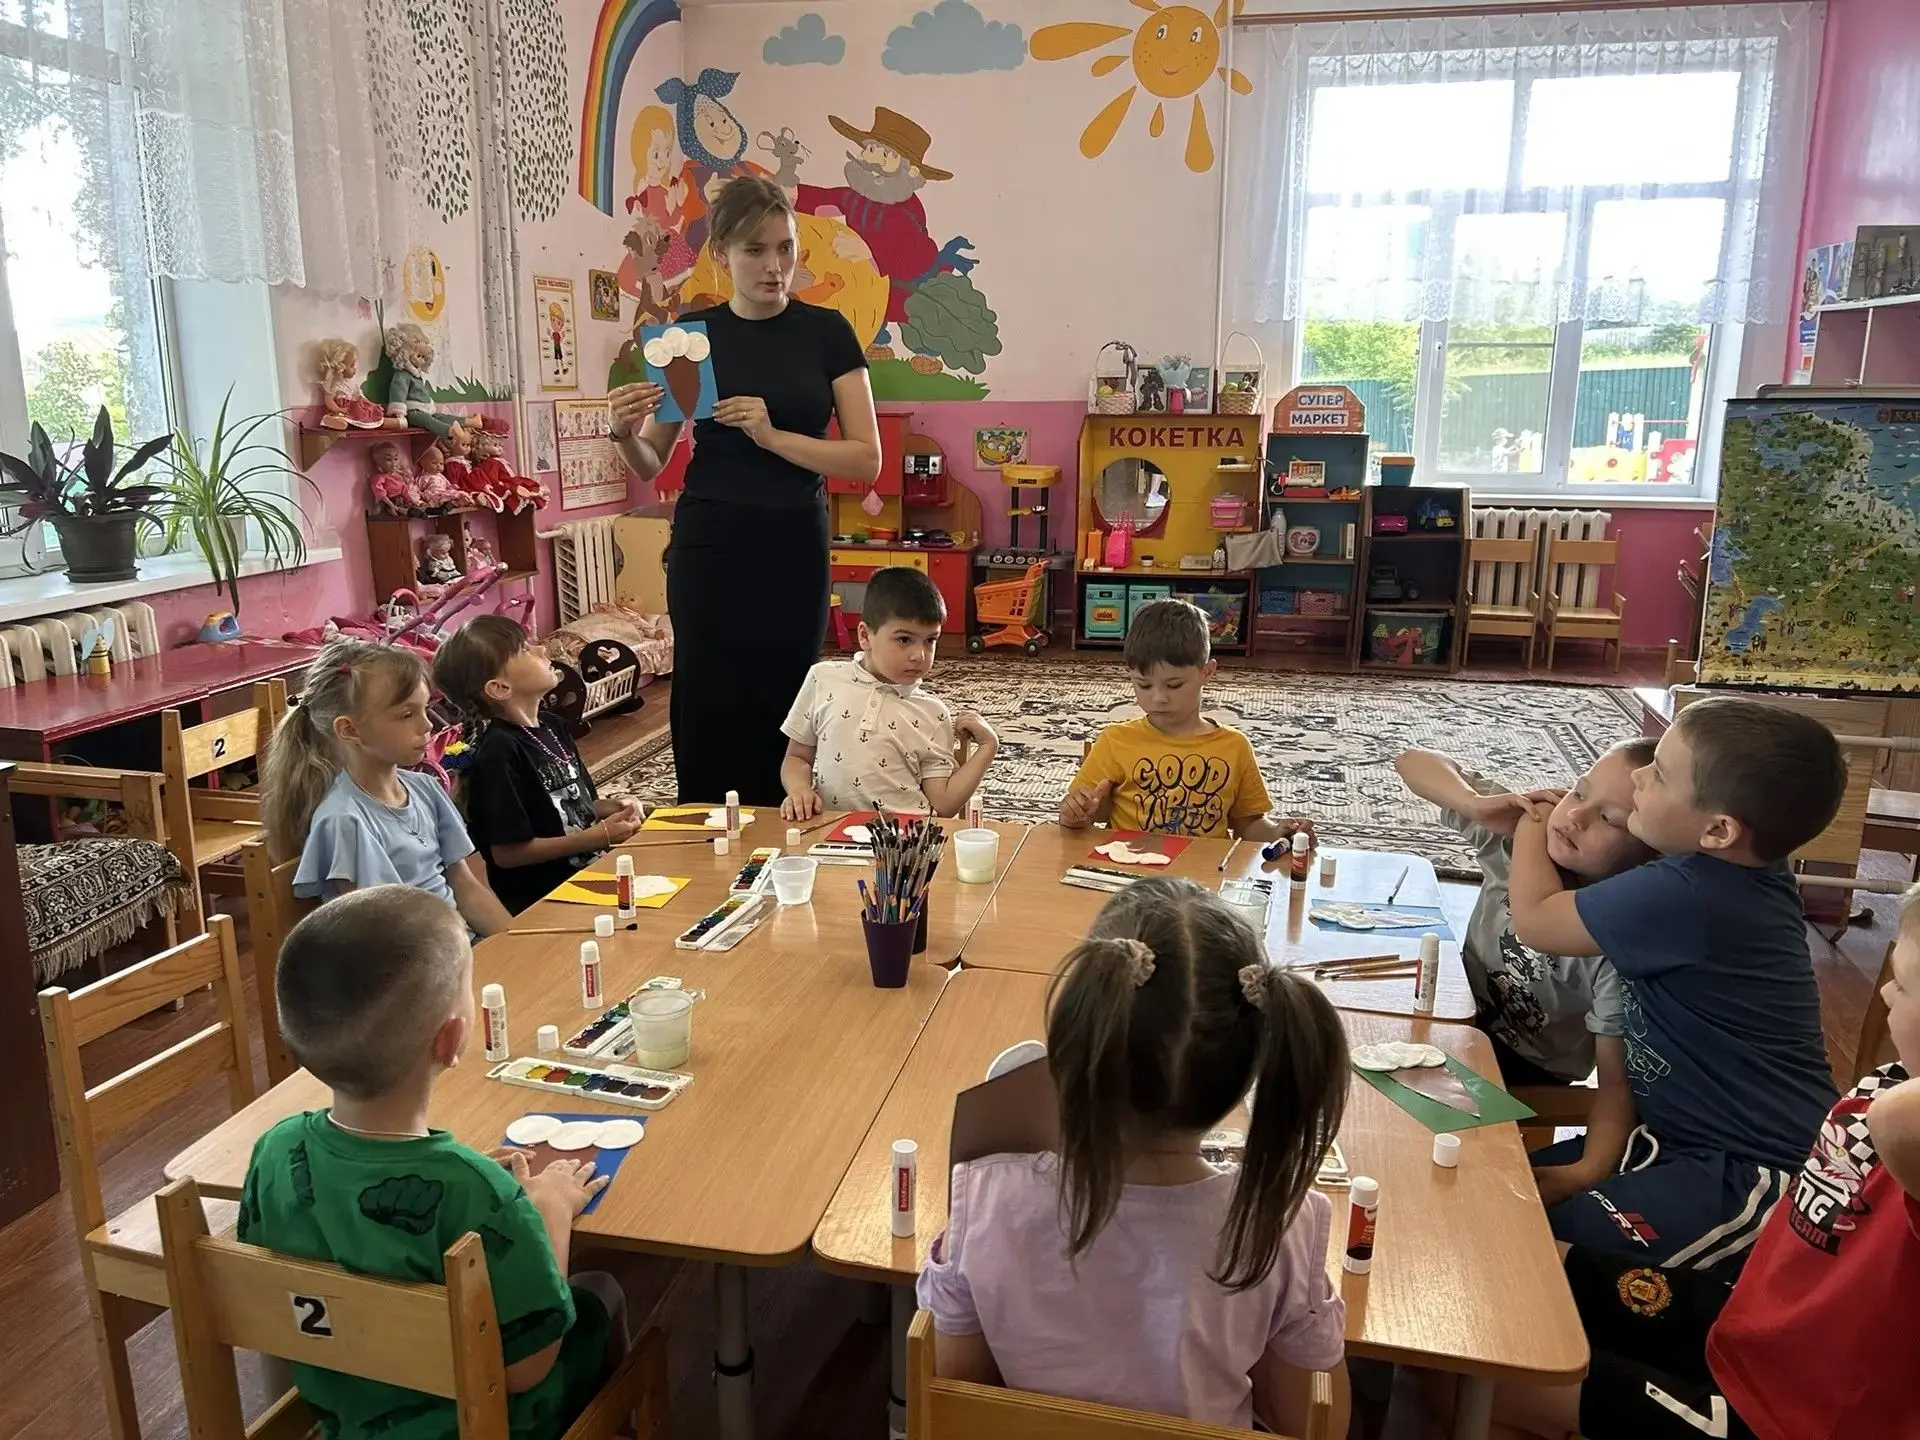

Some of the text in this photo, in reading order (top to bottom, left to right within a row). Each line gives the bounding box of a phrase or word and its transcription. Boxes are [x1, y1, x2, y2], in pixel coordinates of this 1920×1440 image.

[1298, 393, 1344, 408] СУПЕР
[1291, 412, 1348, 427] МАРКЕТ
[1109, 426, 1245, 448] КОКЕТКА
[214, 738, 225, 758] 2
[1133, 754, 1230, 793] GOOD
[293, 1295, 333, 1337] 2
